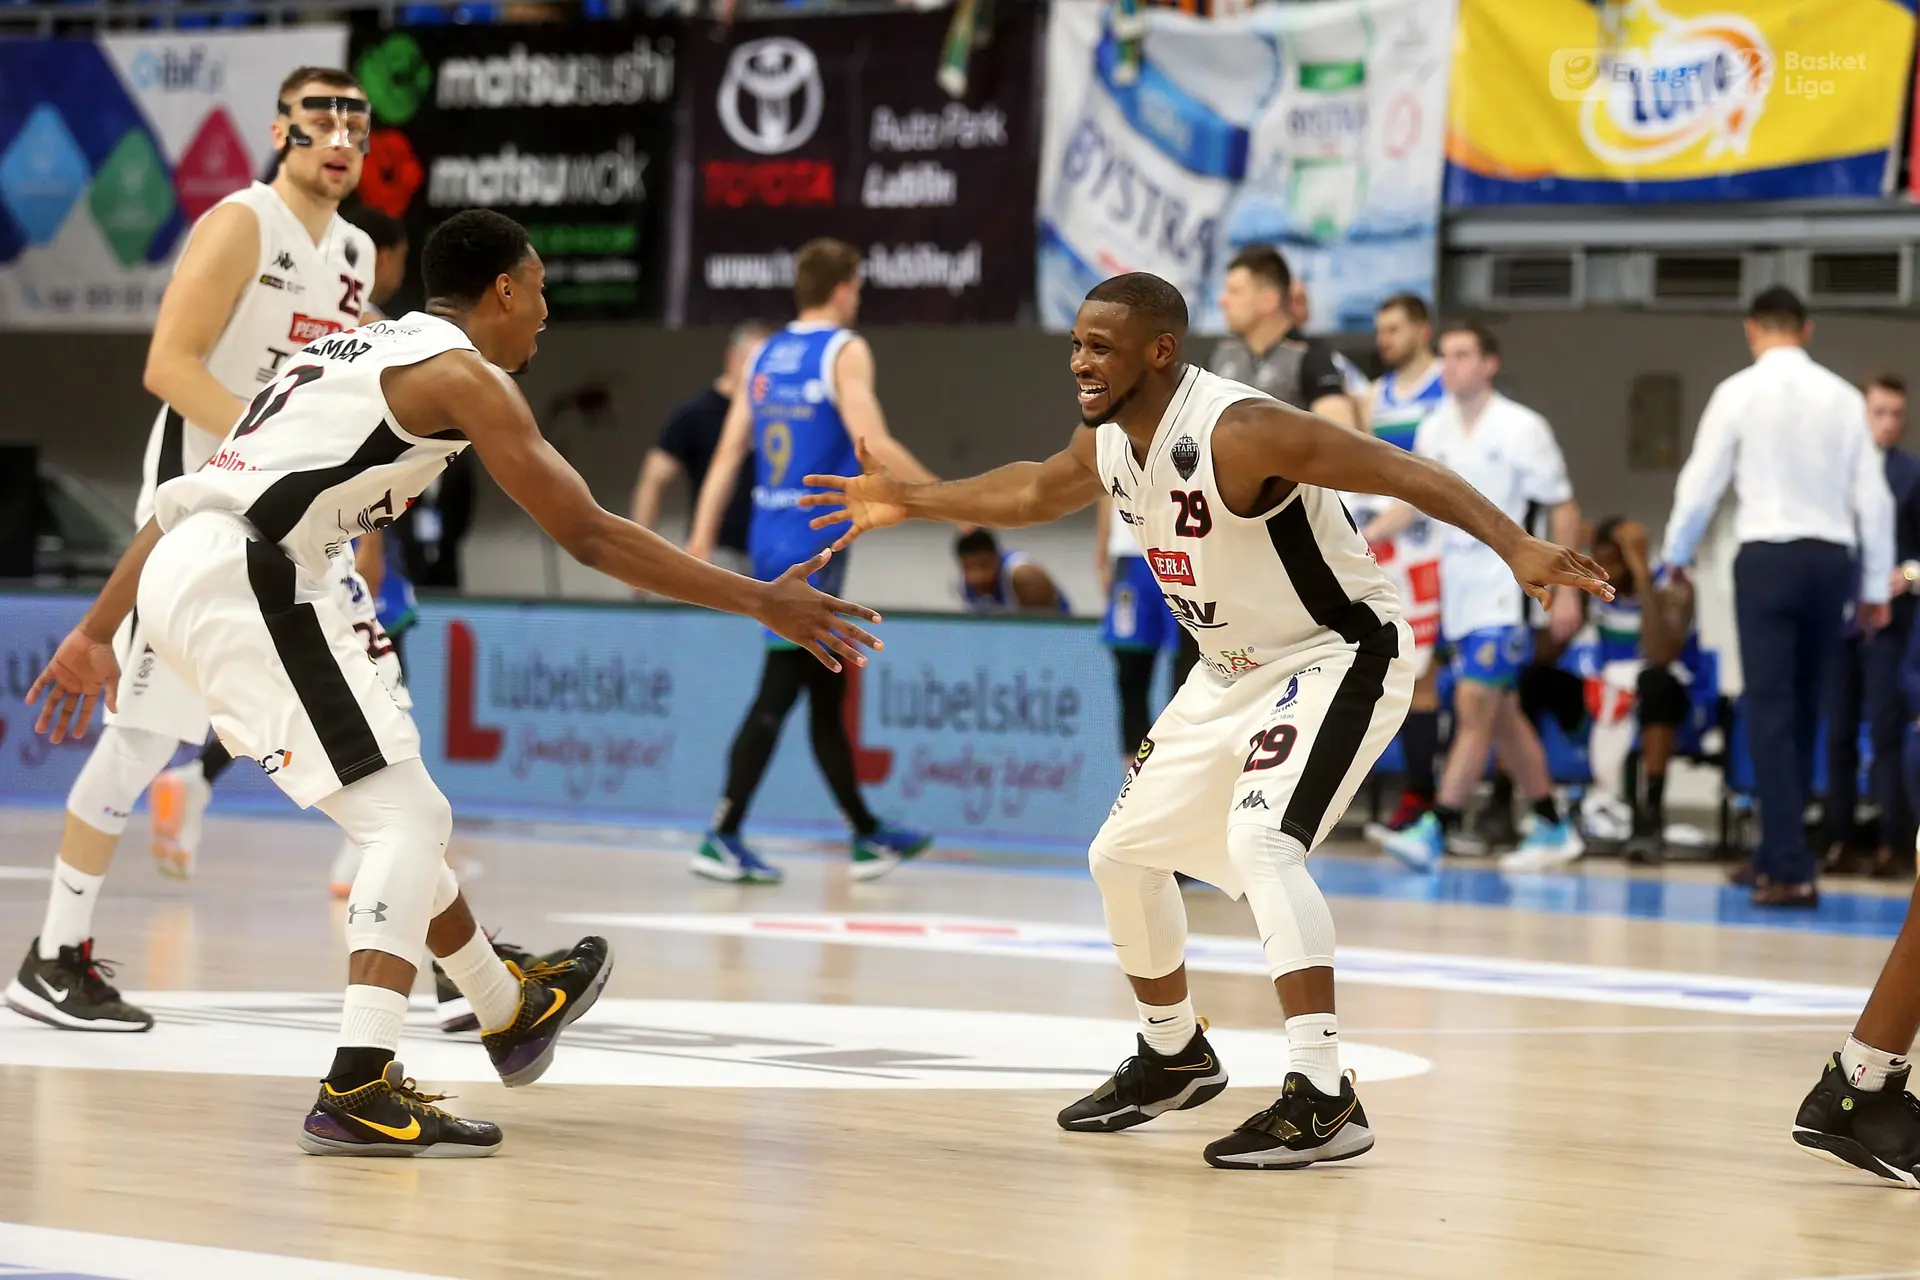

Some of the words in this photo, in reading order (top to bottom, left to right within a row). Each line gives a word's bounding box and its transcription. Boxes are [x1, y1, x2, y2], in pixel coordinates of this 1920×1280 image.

[763, 420, 794, 487] 9
[1172, 444, 1197, 453] START
[1170, 490, 1212, 539] 29
[1154, 557, 1190, 576] PERŁA
[1243, 724, 1298, 773] 29
